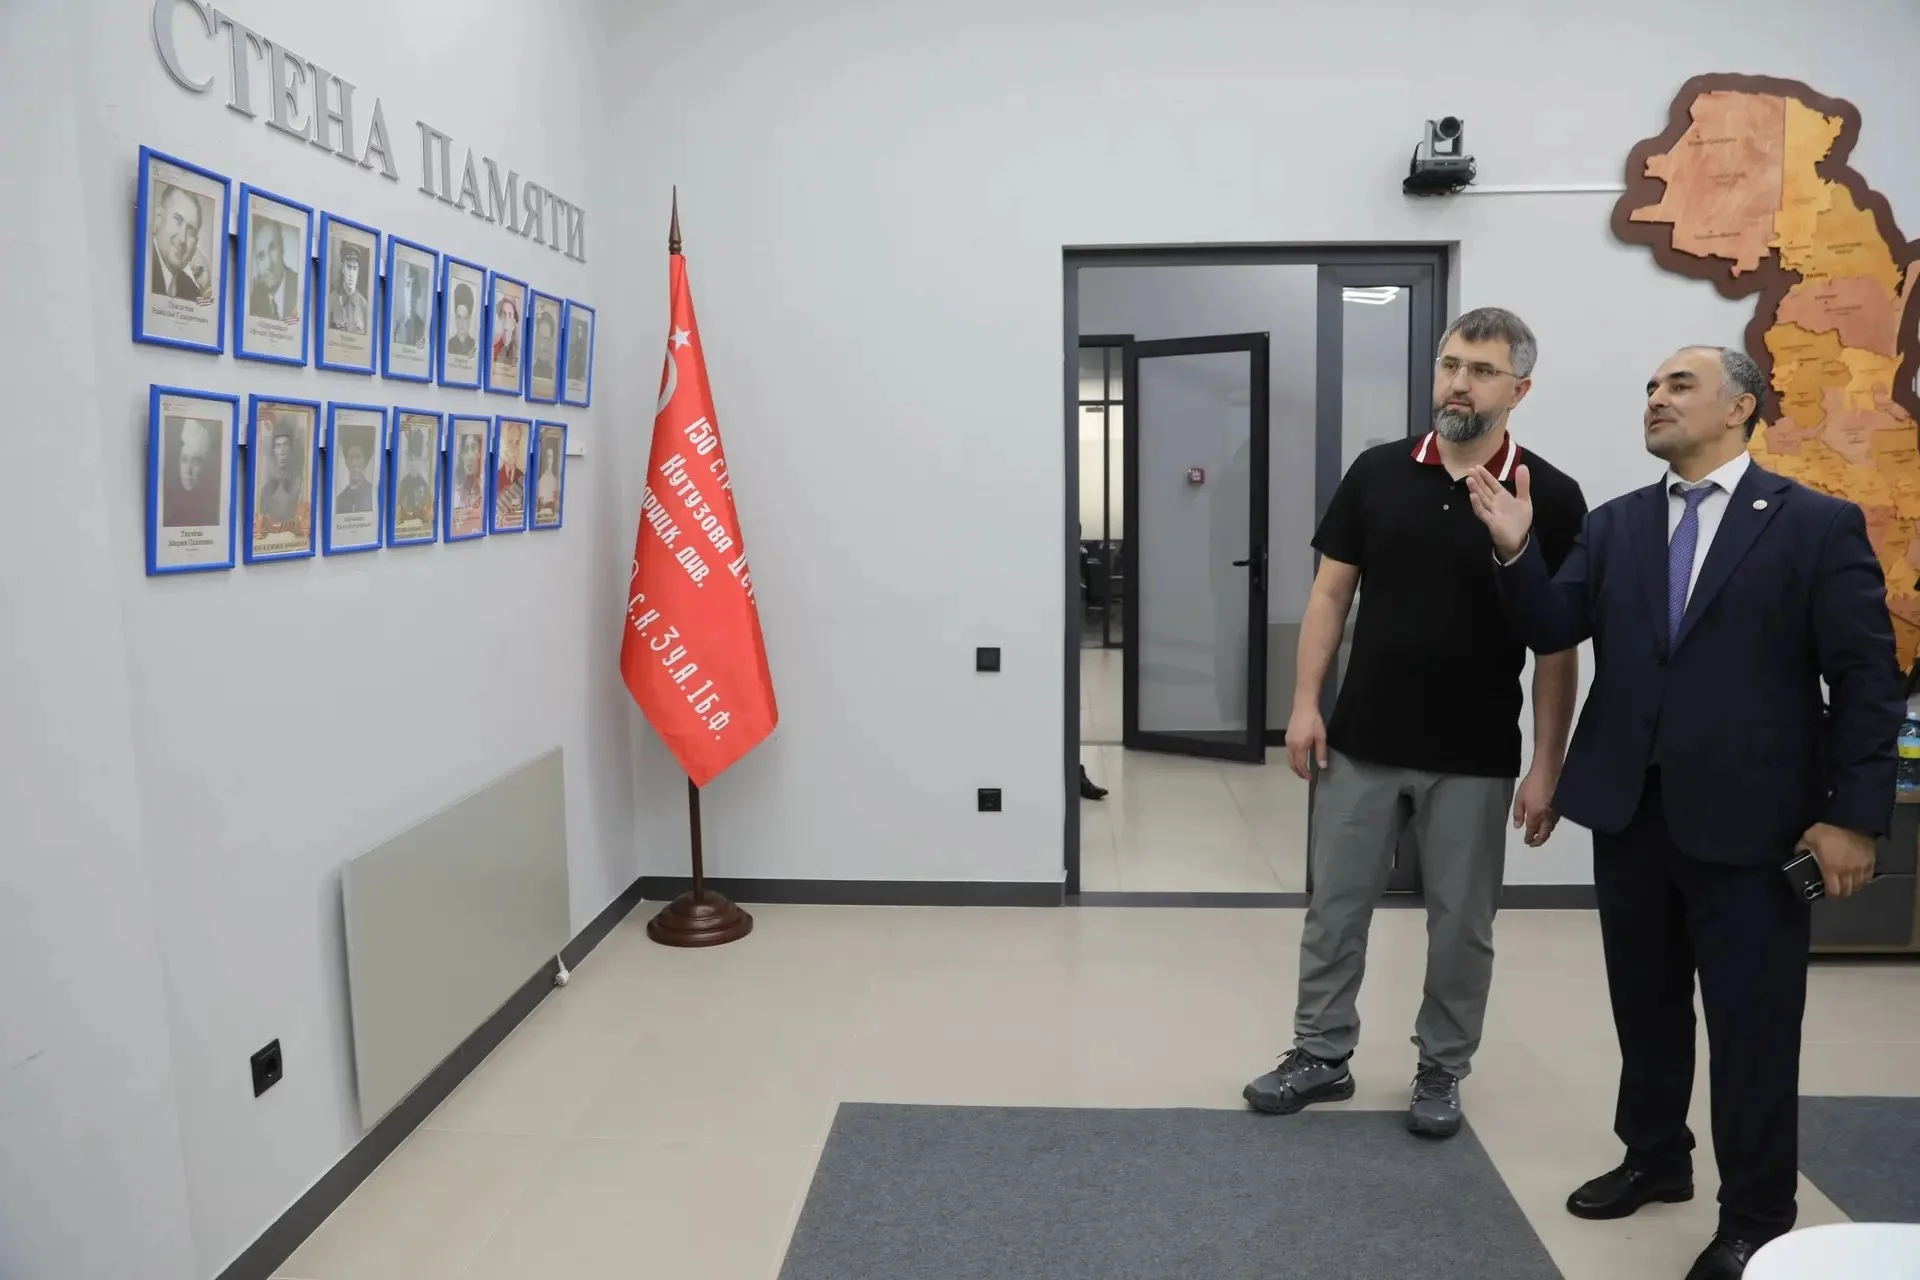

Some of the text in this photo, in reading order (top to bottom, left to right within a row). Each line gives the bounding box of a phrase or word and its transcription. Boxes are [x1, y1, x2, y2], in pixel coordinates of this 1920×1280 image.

[153, 0, 587, 263] СТЕНА ПАМЯТИ
[684, 416, 718, 456] 150
